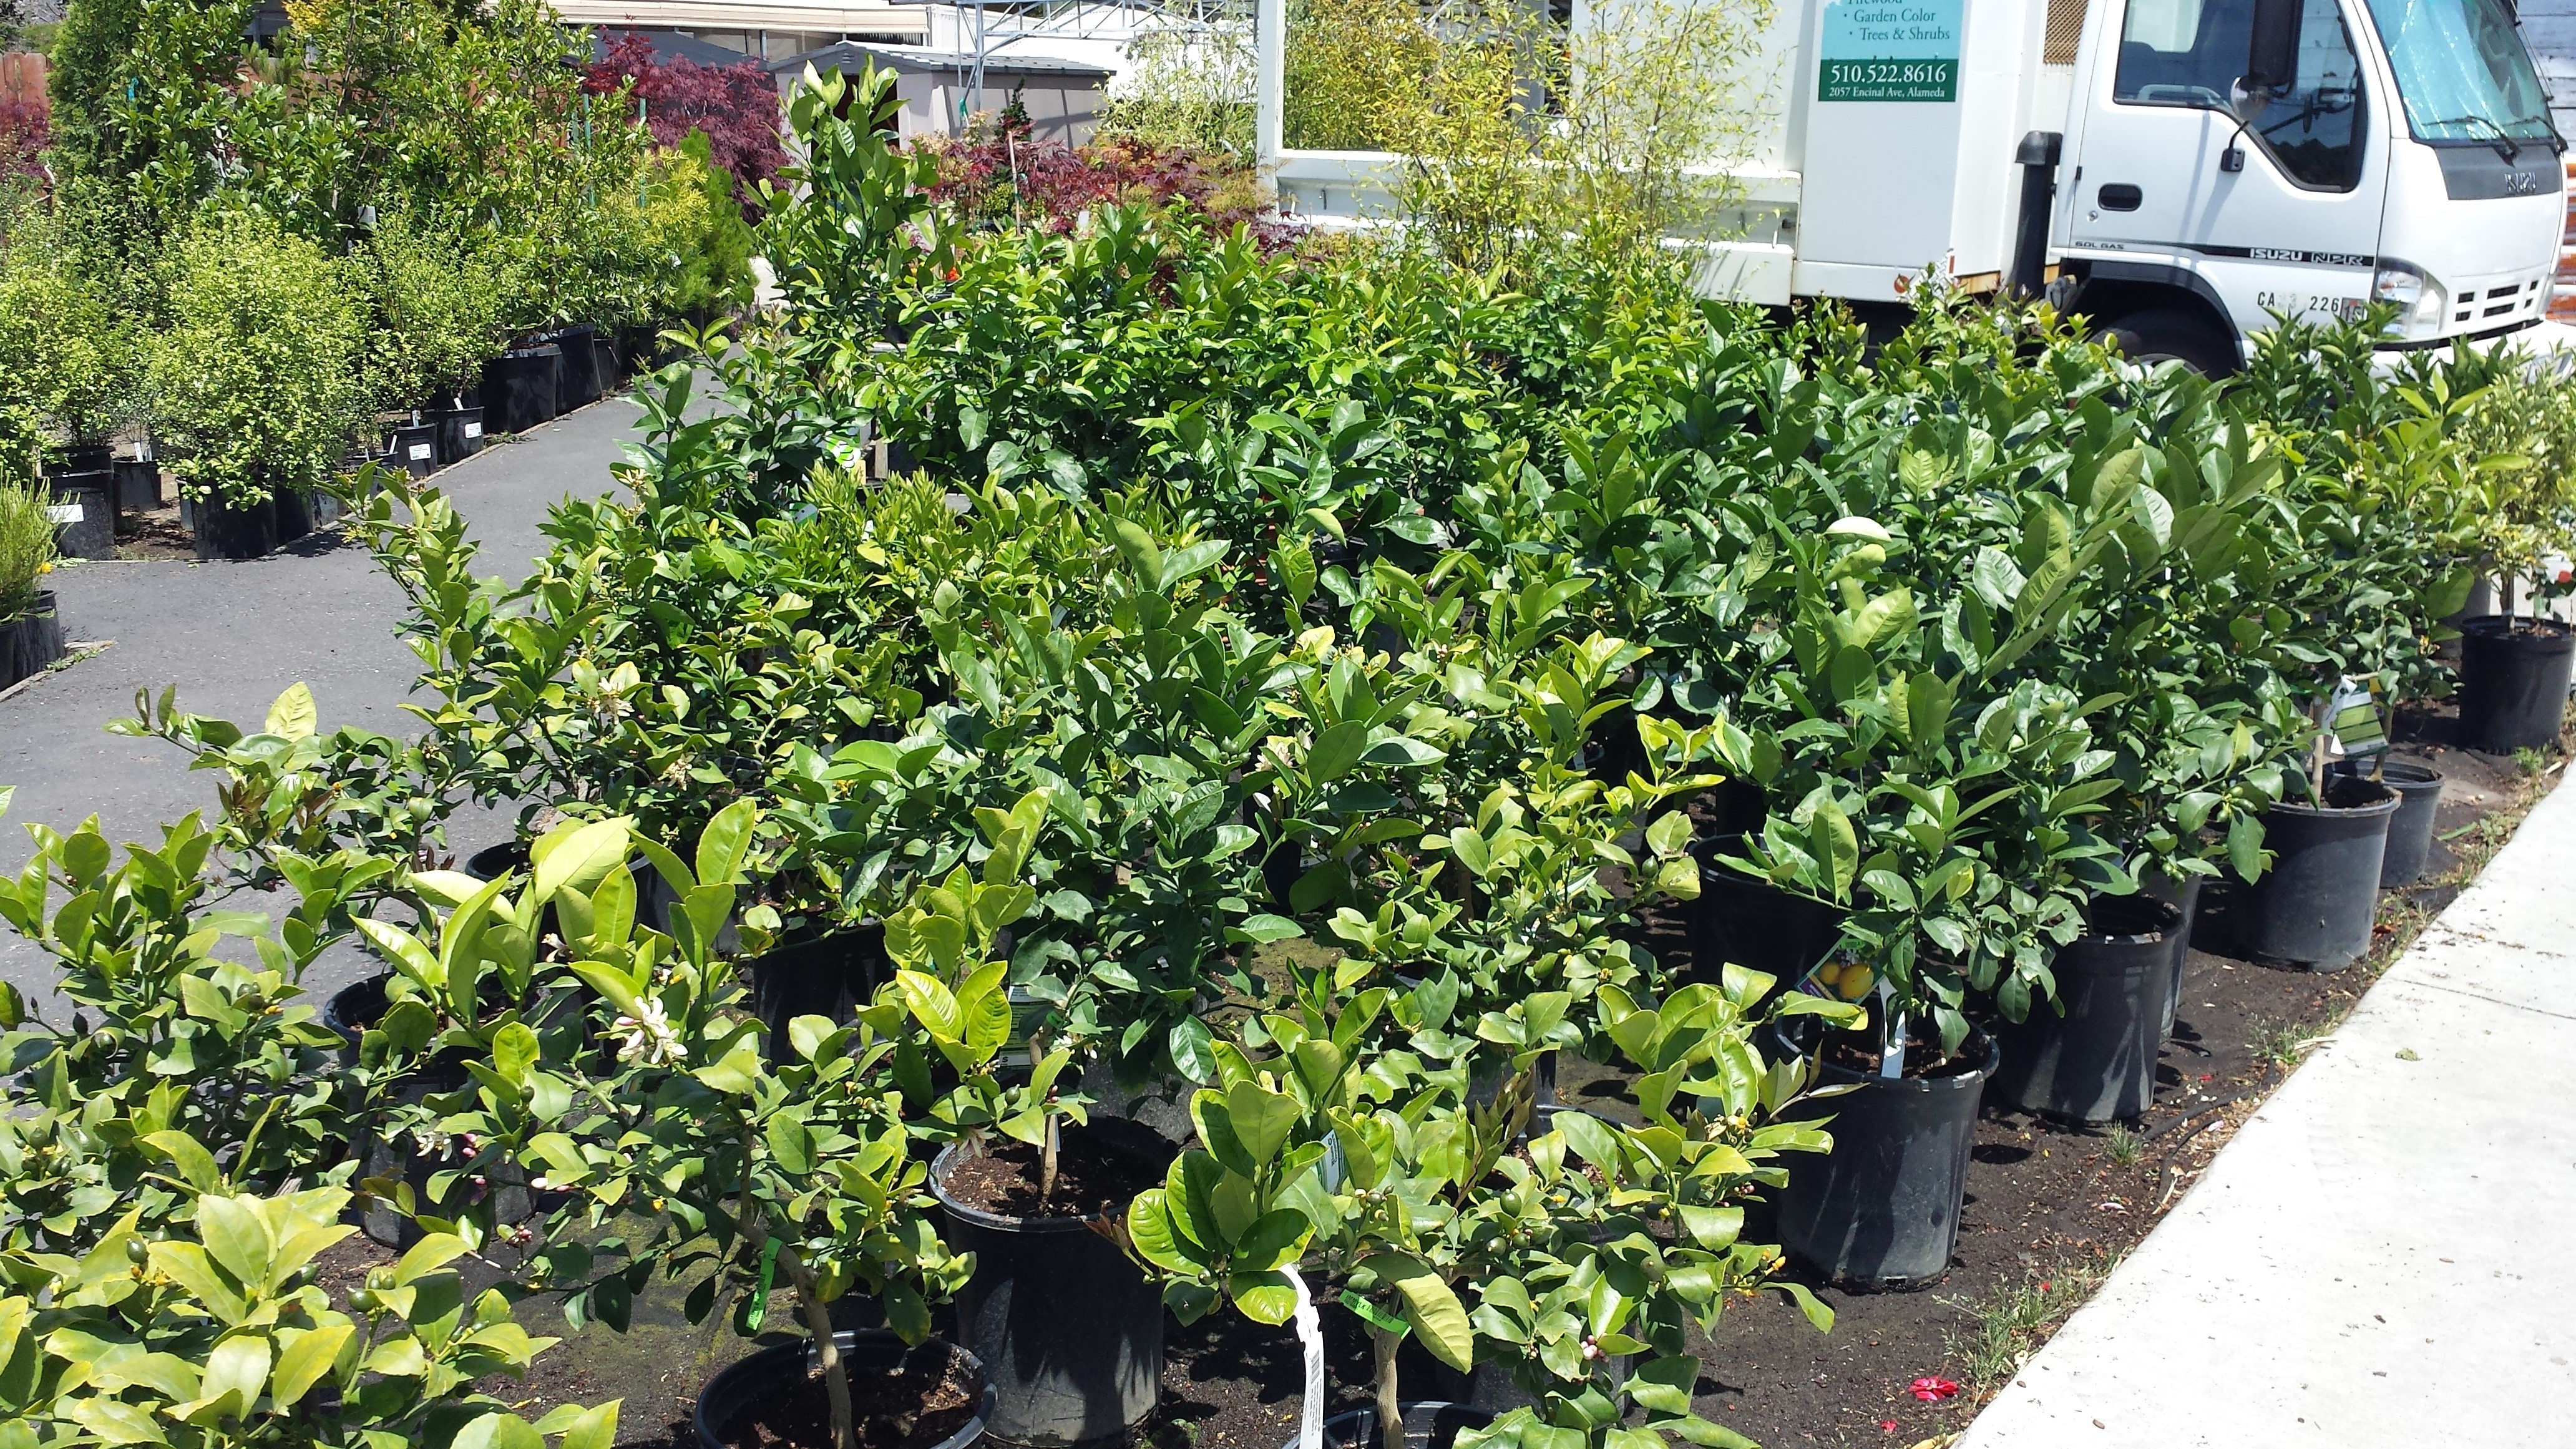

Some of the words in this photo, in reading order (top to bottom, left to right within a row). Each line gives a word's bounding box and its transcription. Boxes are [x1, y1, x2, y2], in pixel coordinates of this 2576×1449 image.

[1854, 9, 1896, 22] Garden
[1901, 8, 1936, 22] Color
[1860, 28, 1888, 41] Trees
[1893, 29, 1905, 40] &
[1909, 27, 1950, 40] Shrubs
[1830, 63, 1947, 84] 510.522.8616
[1828, 87, 1850, 97] 2057
[1853, 87, 1885, 97] Encinal
[1886, 87, 1904, 98] Ave,
[1907, 86, 1945, 97] Alameda
[2250, 248, 2303, 261] ISUZU
[2311, 251, 2364, 266] NPR
[2257, 291, 2275, 306] CA
[2309, 296, 2339, 312] 226
